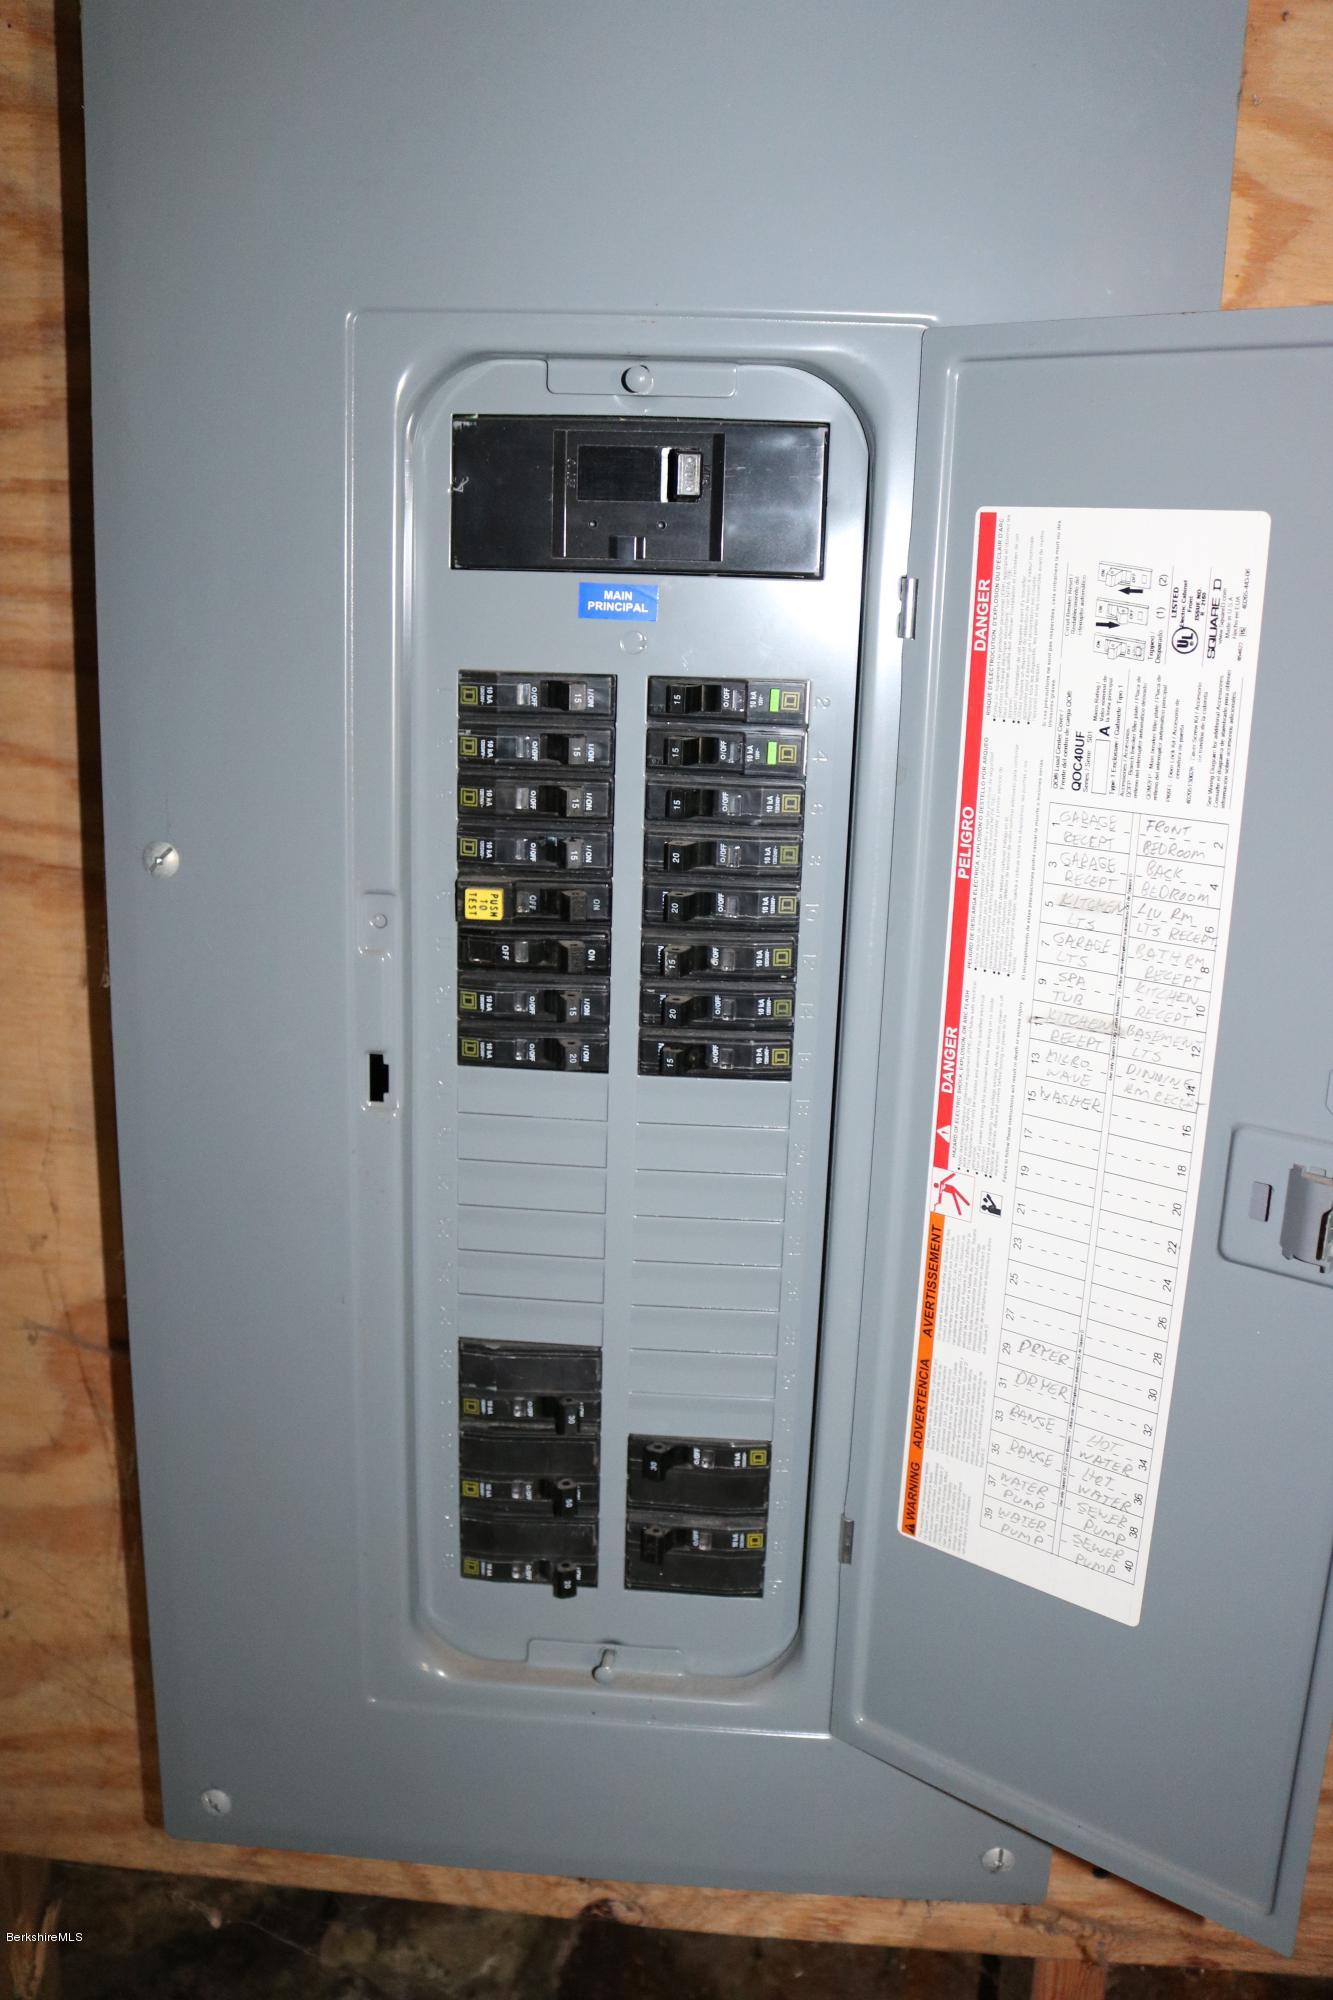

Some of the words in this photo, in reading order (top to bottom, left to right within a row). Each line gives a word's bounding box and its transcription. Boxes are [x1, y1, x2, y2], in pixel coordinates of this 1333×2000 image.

[1158, 574, 1169, 587] (2)
[604, 590, 633, 601] MAIN
[1171, 587, 1180, 618] LISTED
[587, 601, 649, 613] PRINCIPAL
[1156, 606, 1166, 620] (1)
[973, 578, 990, 652] DANGER
[1206, 598, 1220, 659] SQUARE
[1213, 578, 1222, 591] D
[1176, 633, 1194, 648] UL
[574, 694, 582, 703] 15
[674, 694, 681, 704] 15
[1098, 726, 1110, 737] A
[572, 747, 581, 757] 15
[672, 748, 680, 758] 15
[1071, 731, 1086, 792] QOC40UF
[572, 798, 580, 808] 15
[673, 800, 680, 810] 15
[1059, 810, 1117, 831] GARAGE
[1146, 819, 1192, 836] FRONT
[957, 806, 974, 880] PELIGRO
[1063, 831, 1115, 849] RECEPT
[570, 850, 578, 860] 15
[1143, 840, 1206, 860] BEDROOM
[672, 852, 680, 863] 20
[1059, 852, 1116, 873] GARAGE
[1146, 859, 1184, 879] BACK
[1064, 870, 1118, 889] RECEPT
[1141, 881, 1210, 904] BEDROOM
[468, 892, 478, 916] TEST
[479, 898, 486, 910] TO
[490, 893, 500, 918] PUSH
[529, 894, 537, 910] OFF
[593, 898, 600, 911] ON
[671, 902, 679, 913] 20
[1052, 932, 1113, 953] GARAGE
[502, 945, 510, 960] OFF
[588, 950, 596, 962] ON
[668, 959, 676, 969] 15
[1058, 972, 1086, 986] SPA
[1052, 990, 1084, 1006] TUB
[1135, 981, 1199, 1004] KITCHEN
[569, 1006, 577, 1017] 15
[669, 1008, 677, 1018] 20
[1196, 1005, 1206, 1018] 10
[569, 1054, 577, 1064] 20
[1032, 1052, 1040, 1064] 13
[1192, 1046, 1201, 1058] 12
[666, 1058, 674, 1068] 15
[941, 1026, 958, 1094] DANGER
[1028, 1090, 1037, 1102] 15
[1040, 1086, 1104, 1113] WASHER
[1024, 1128, 1033, 1140] 17
[1182, 1124, 1192, 1138] 16
[1020, 1165, 1030, 1177] 19
[1177, 1164, 1187, 1177] 18
[1016, 1202, 1026, 1215] 21
[1172, 1202, 1182, 1216] 20
[1013, 1237, 1022, 1250] 23
[1168, 1240, 1178, 1254] 22
[922, 1224, 942, 1338] AVERTISSEMENT
[1010, 1272, 1019, 1286] 25
[1162, 1278, 1172, 1292] 24
[1006, 1308, 1015, 1320] 27
[1158, 1316, 1168, 1330] 26
[1002, 1342, 1012, 1355] 29
[1017, 1339, 1070, 1366] DRYER
[1152, 1352, 1163, 1366] 28
[998, 1377, 1008, 1388] 31
[1015, 1370, 1069, 1400] DRYER
[1148, 1388, 1158, 1401] 30
[912, 1358, 930, 1448] ADVERTENCIA
[568, 1415, 576, 1424] 30
[995, 1410, 1004, 1422] 33
[1142, 1424, 1153, 1436] 32
[992, 1443, 1000, 1455] 35
[1079, 1451, 1134, 1477] WATER
[1138, 1458, 1148, 1472] 34
[988, 1474, 996, 1486] 37
[1001, 1473, 1049, 1496] WATER
[906, 1462, 920, 1520] WARNING
[1003, 1490, 1045, 1510] PUMP
[1078, 1485, 1132, 1513] WATER
[1134, 1493, 1144, 1506] 36
[984, 1508, 993, 1519] 39
[998, 1507, 1047, 1530] WATER
[1077, 1501, 1128, 1528] SEWER
[1000, 1523, 1044, 1545] PUMP
[1084, 1518, 1126, 1544] PUMP
[1128, 1526, 1139, 1539] 38
[1073, 1533, 1126, 1560] SEWER
[1076, 1553, 1116, 1574] PUMP
[1124, 1560, 1134, 1572] 40
